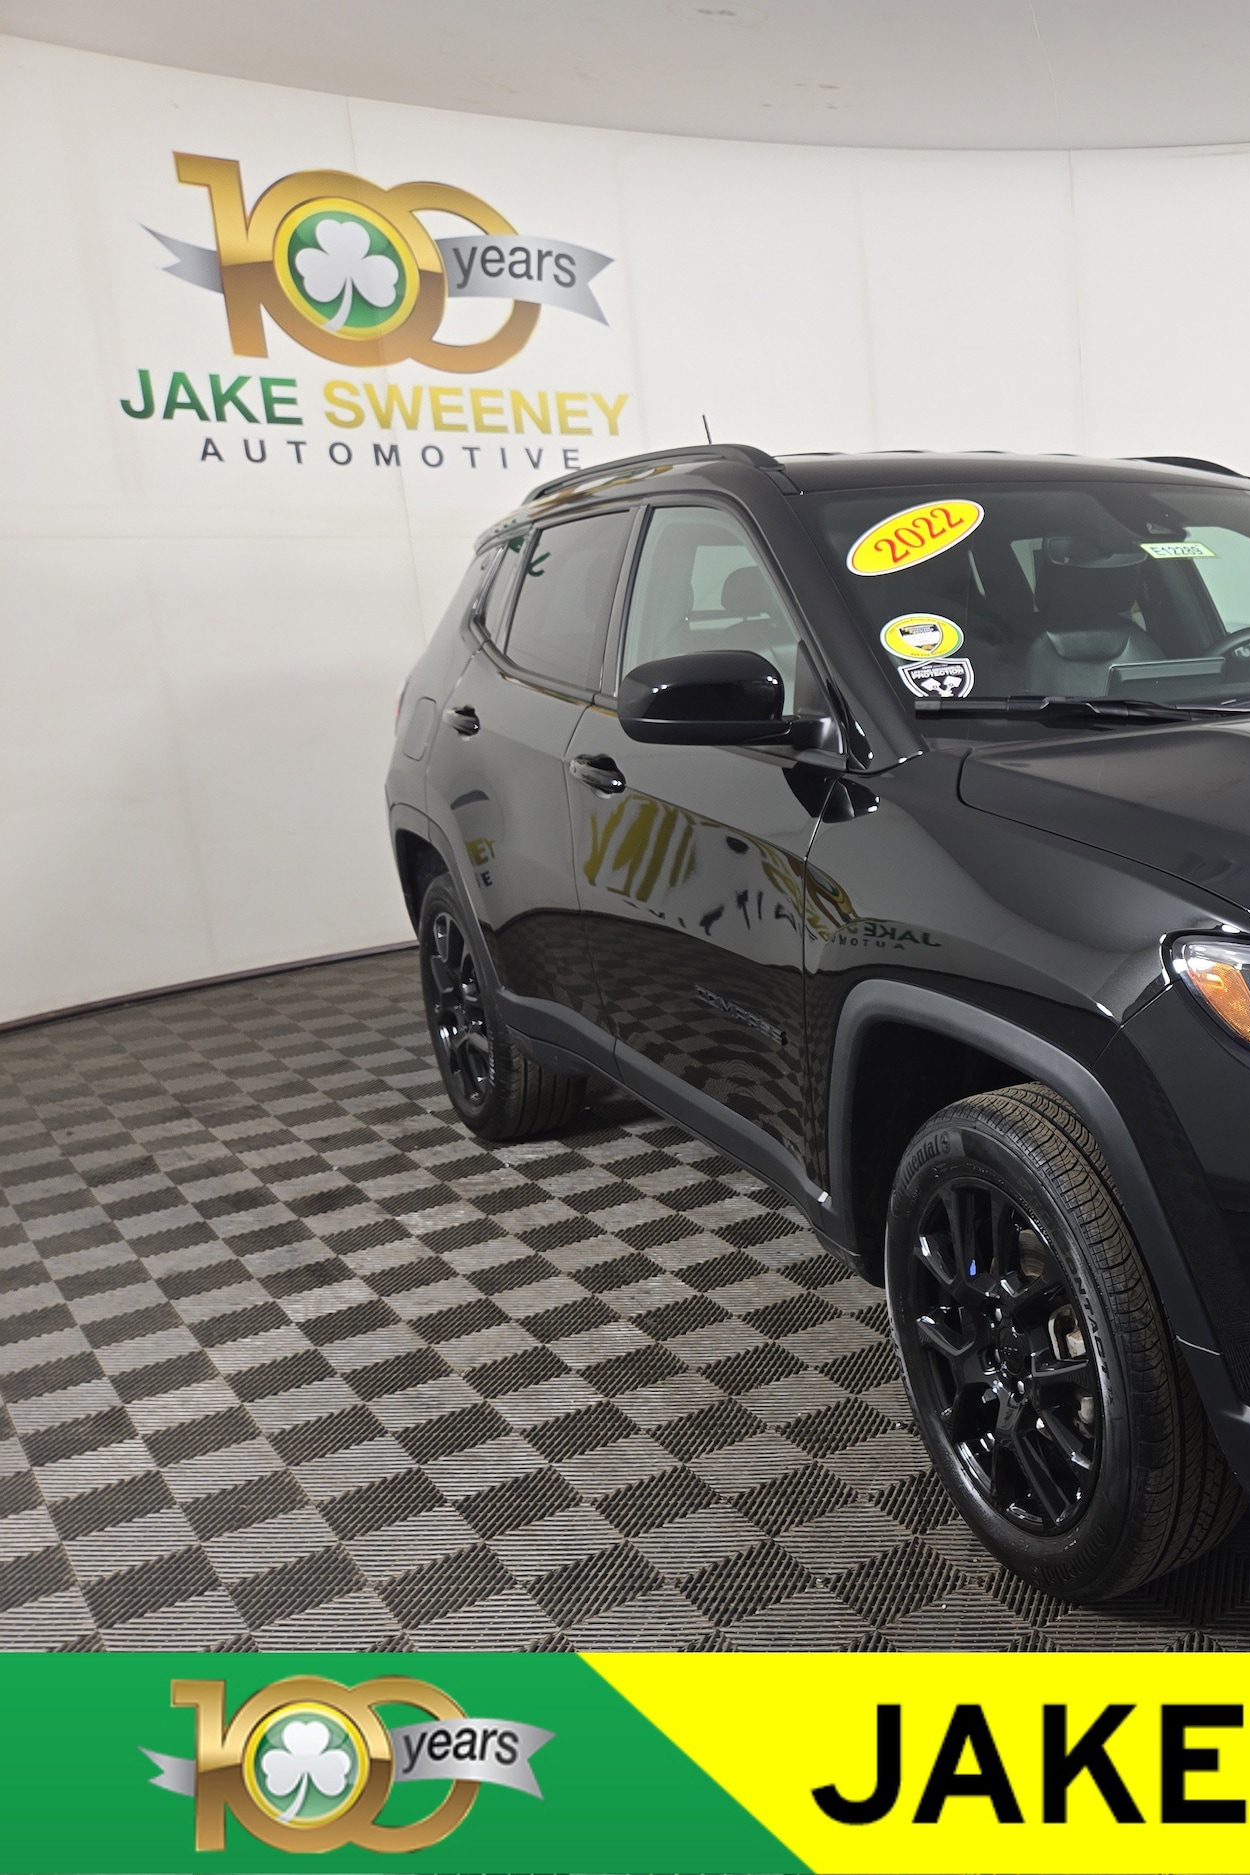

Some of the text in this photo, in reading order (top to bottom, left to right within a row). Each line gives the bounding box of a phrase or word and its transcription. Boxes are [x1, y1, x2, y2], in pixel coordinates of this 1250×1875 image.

[453, 245, 578, 290] years
[120, 368, 632, 437] JAKE SWEENEY
[200, 437, 582, 471] AUTOMOTIVE
[874, 507, 965, 565] 2022
